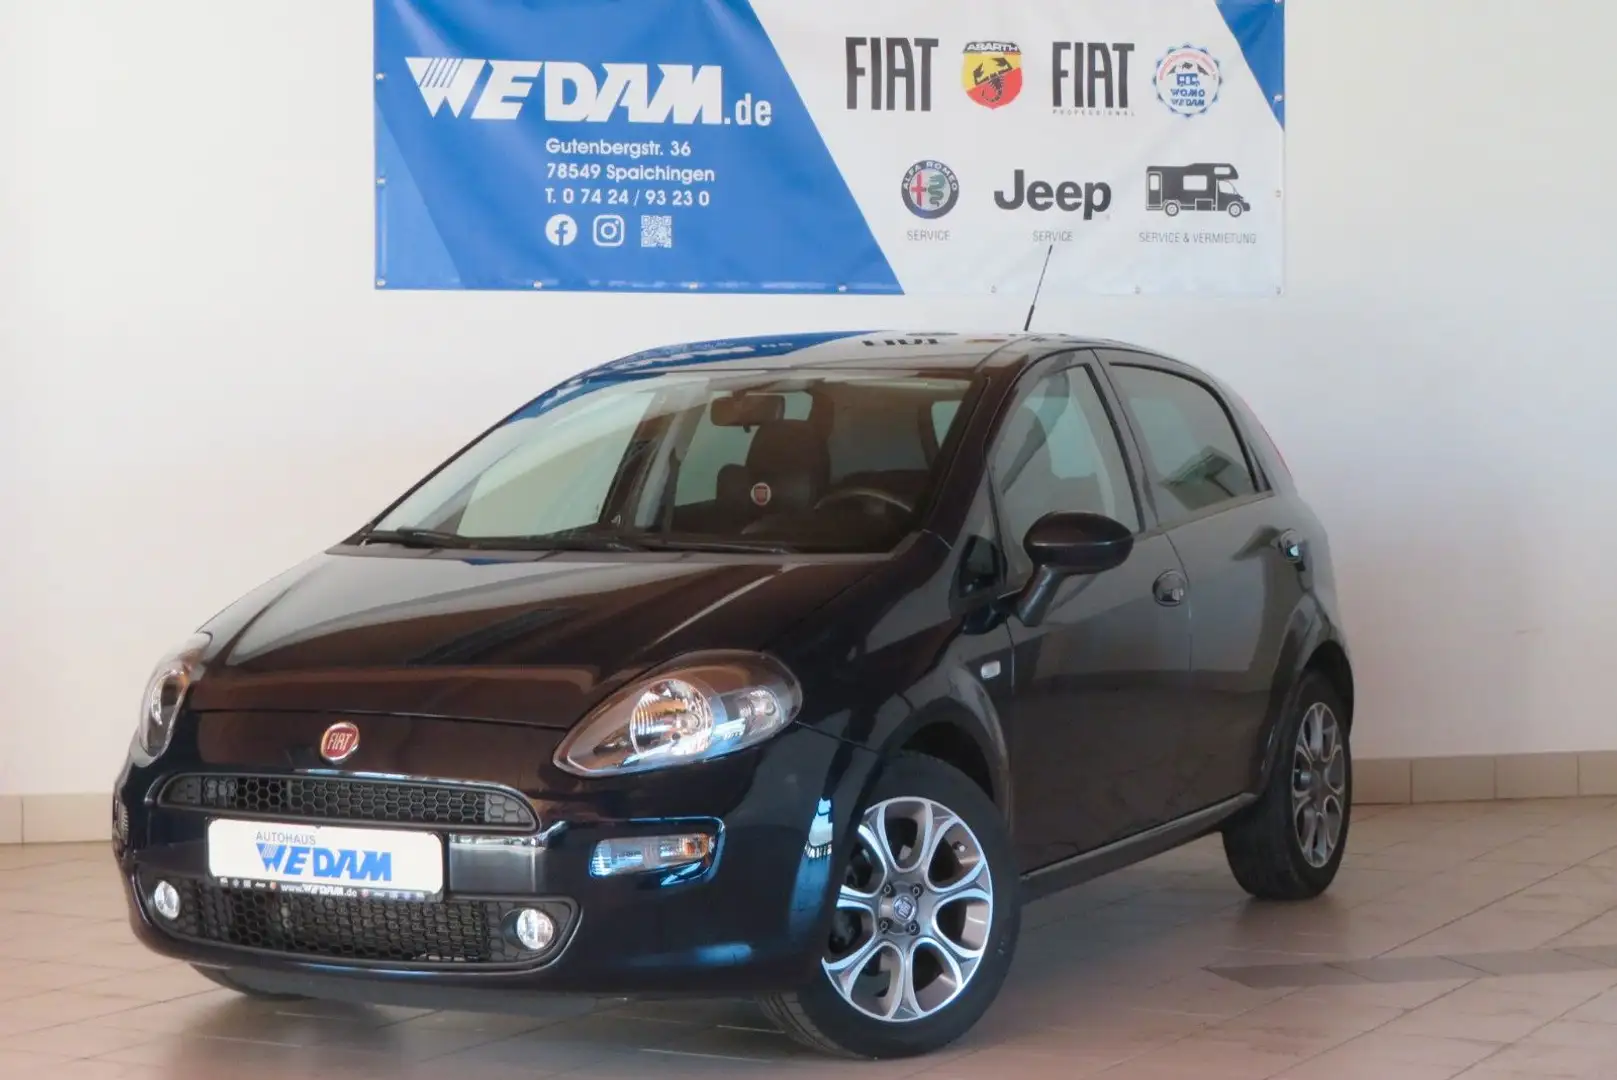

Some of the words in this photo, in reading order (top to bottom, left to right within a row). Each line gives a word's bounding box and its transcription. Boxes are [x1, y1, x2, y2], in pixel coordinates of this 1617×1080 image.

[967, 42, 1018, 52] ABARTH
[845, 37, 939, 111] FIAT
[1052, 41, 1135, 108] FIAT
[405, 56, 772, 126] WEDAM.de
[1170, 88, 1205, 98] WOMO
[545, 137, 664, 159] Gutenbergstr.
[670, 139, 691, 156] 36
[547, 162, 601, 179] 78549
[606, 163, 715, 185] Spaichingen
[902, 163, 922, 190] ALFA
[925, 160, 958, 191] ROMEO
[545, 187, 556, 203] T.
[563, 187, 574, 204] 0
[581, 187, 602, 204] 74
[607, 188, 629, 205] 24
[645, 189, 667, 206] 93
[672, 190, 693, 206] 23
[698, 190, 710, 207] 0
[994, 169, 1111, 220] Jeep
[907, 229, 951, 241] SERVICE
[1032, 230, 1073, 241] SERVICE
[1139, 231, 1181, 243] SERVICE
[1183, 232, 1190, 243] &
[1193, 232, 1257, 244] VERMIETUNG
[327, 732, 353, 751] FIAT
[256, 831, 316, 845] AUTOHAUS
[256, 843, 392, 882] WEDAM
